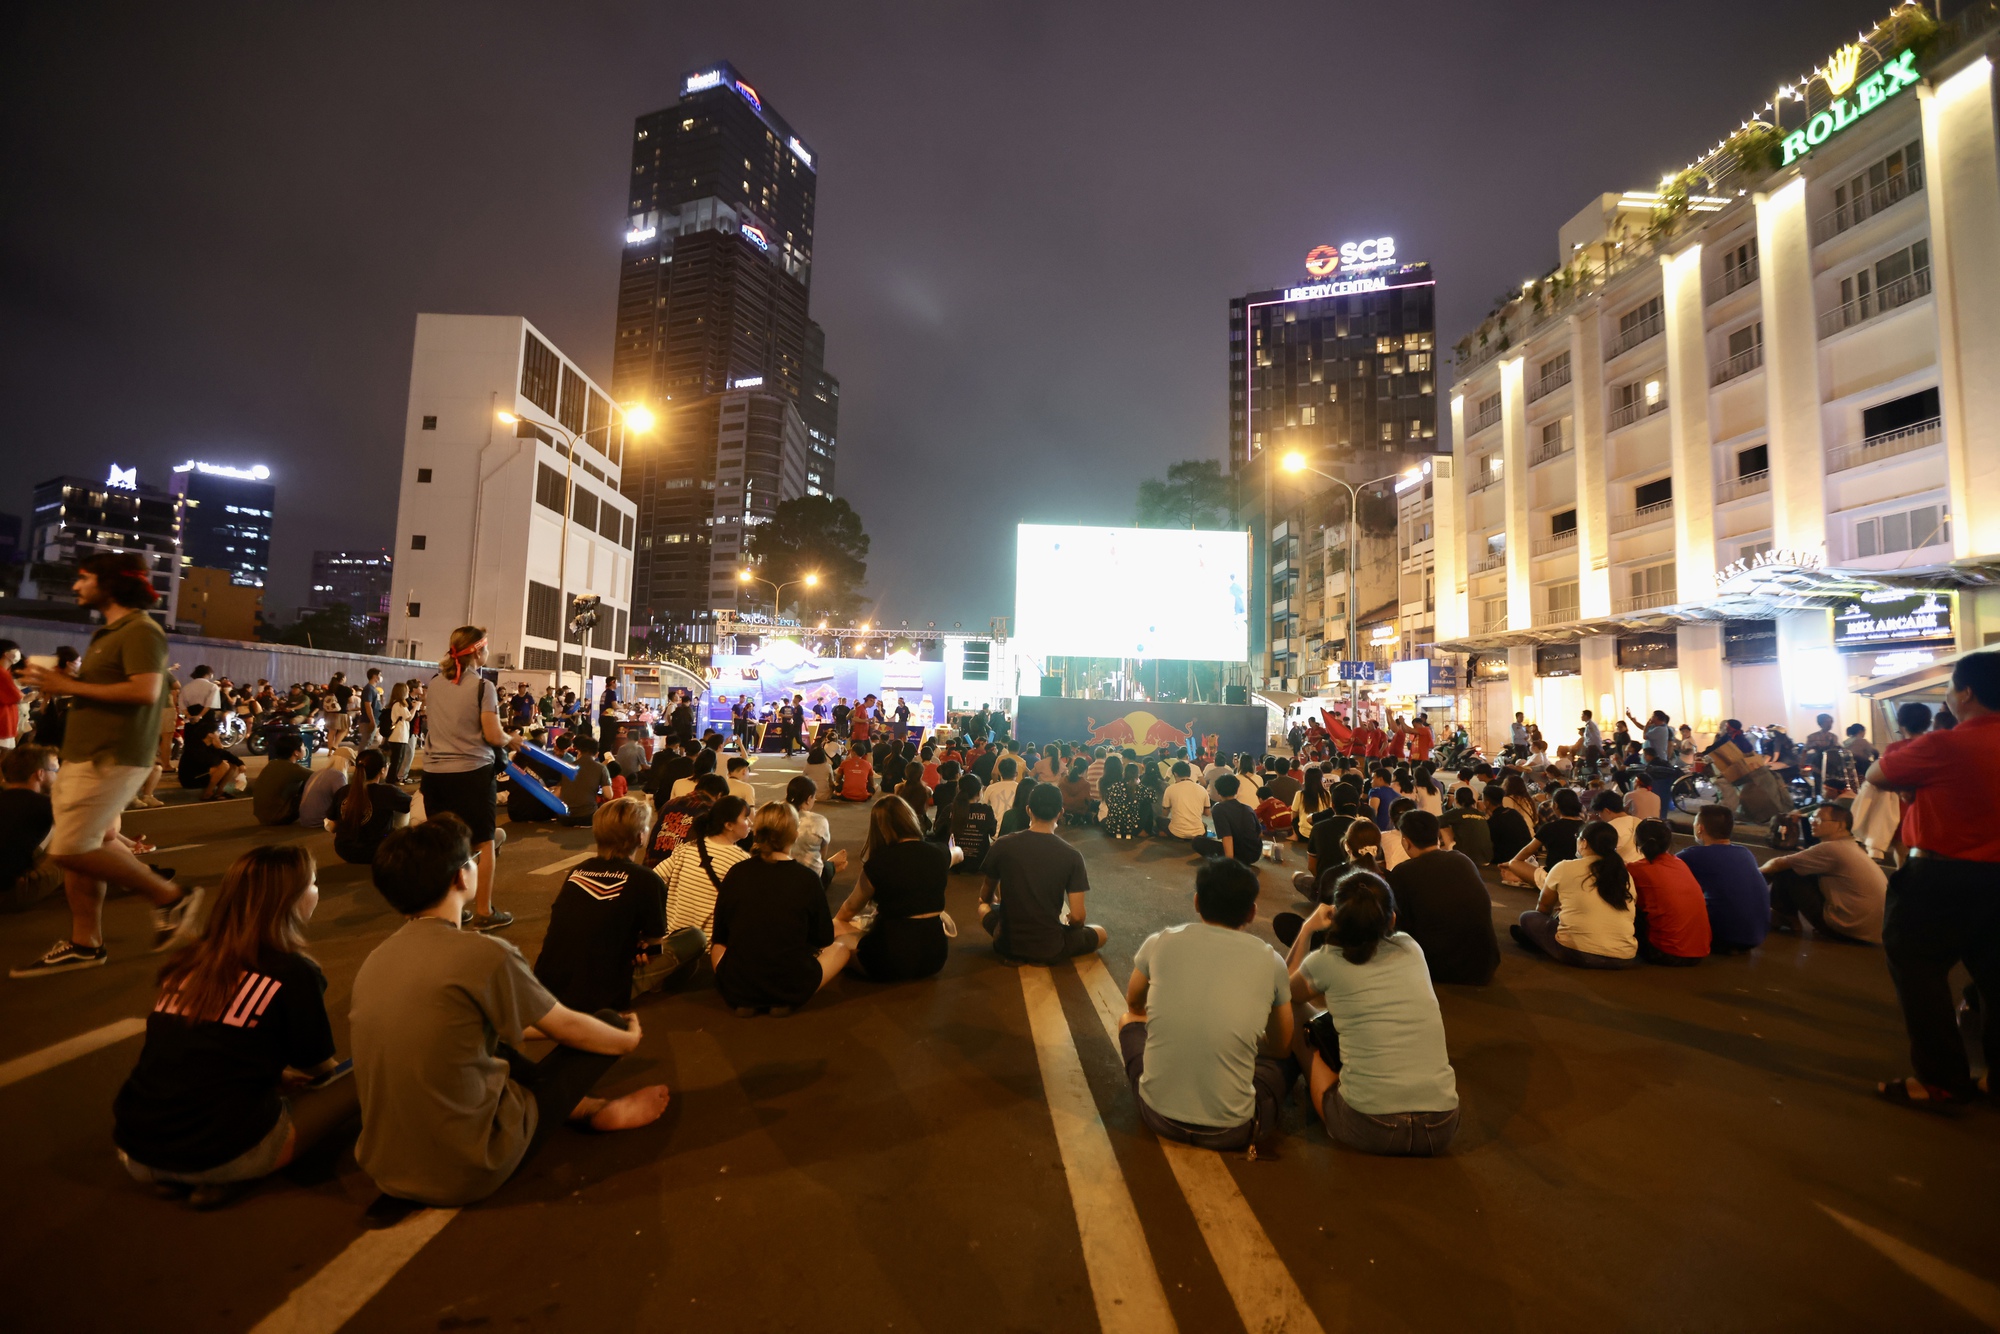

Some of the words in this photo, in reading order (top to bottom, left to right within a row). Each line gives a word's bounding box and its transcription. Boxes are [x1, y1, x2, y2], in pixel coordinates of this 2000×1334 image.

[1780, 48, 1921, 166] ROLEX
[1340, 236, 1395, 264] SCB
[1284, 284, 1331, 301] LIBERTY
[1331, 277, 1389, 296] CENTRAL
[1713, 557, 1749, 587] REX
[1752, 548, 1823, 571] ARCADE
[741, 615, 772, 626] SAIGO
[1876, 613, 1937, 631] ARCADE
